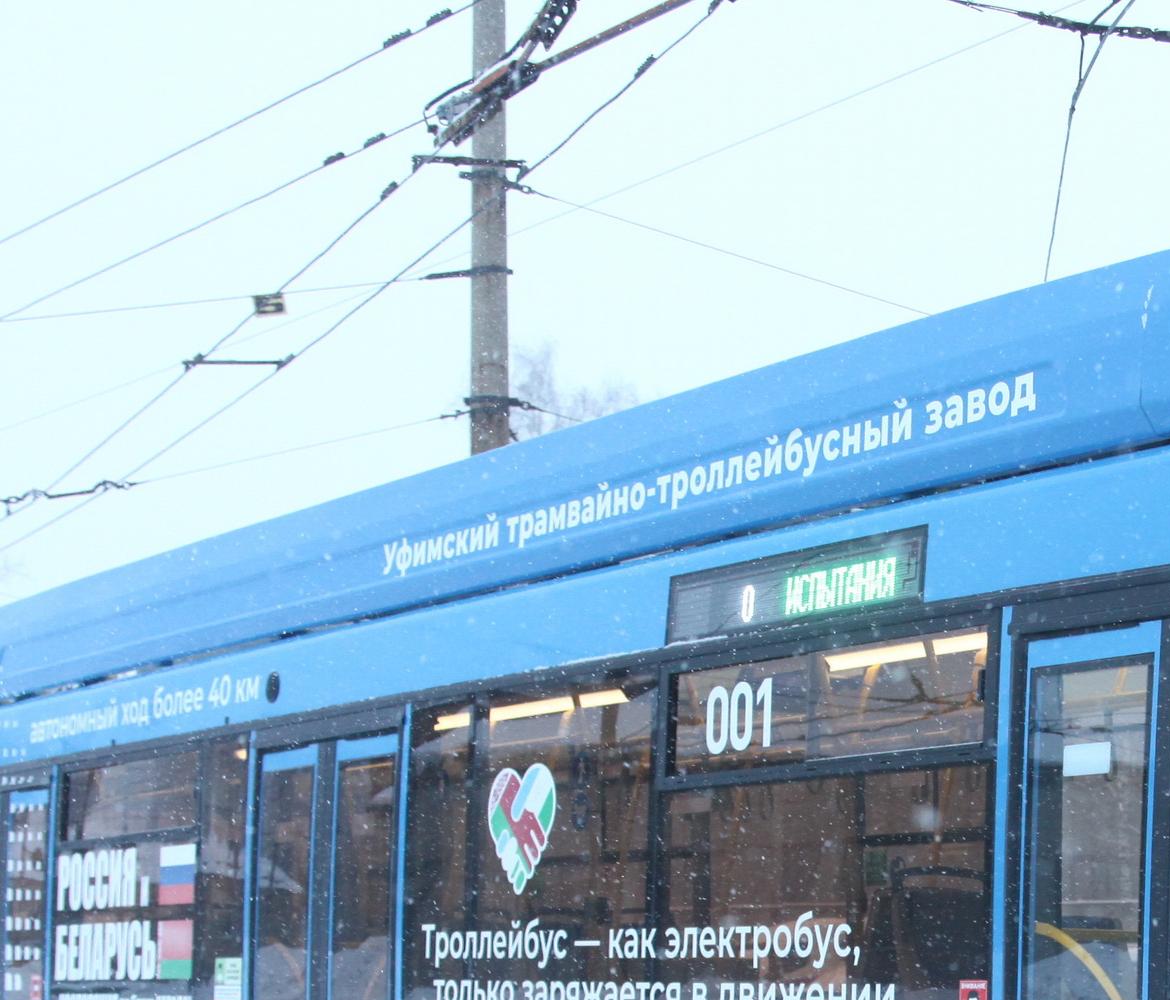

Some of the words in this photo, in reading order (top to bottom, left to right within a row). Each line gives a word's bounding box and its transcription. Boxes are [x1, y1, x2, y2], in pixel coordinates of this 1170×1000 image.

[383, 512, 500, 576] Уфимский
[506, 399, 912, 548] трамвайно-троллейбусный
[924, 371, 1037, 434] завод
[784, 556, 897, 616] ИСПЫТАНИЯ
[30, 699, 118, 744] автономный
[121, 696, 149, 727] ход
[152, 685, 203, 720] более
[207, 674, 232, 707] 40
[235, 675, 261, 704] км
[706, 677, 773, 755] 001
[56, 847, 138, 911] РОССИЯ
[54, 920, 157, 981] БЕЛАРУСЬ
[421, 918, 568, 969] Троллейбус
[608, 924, 657, 959] как
[665, 910, 861, 969] электробус,
